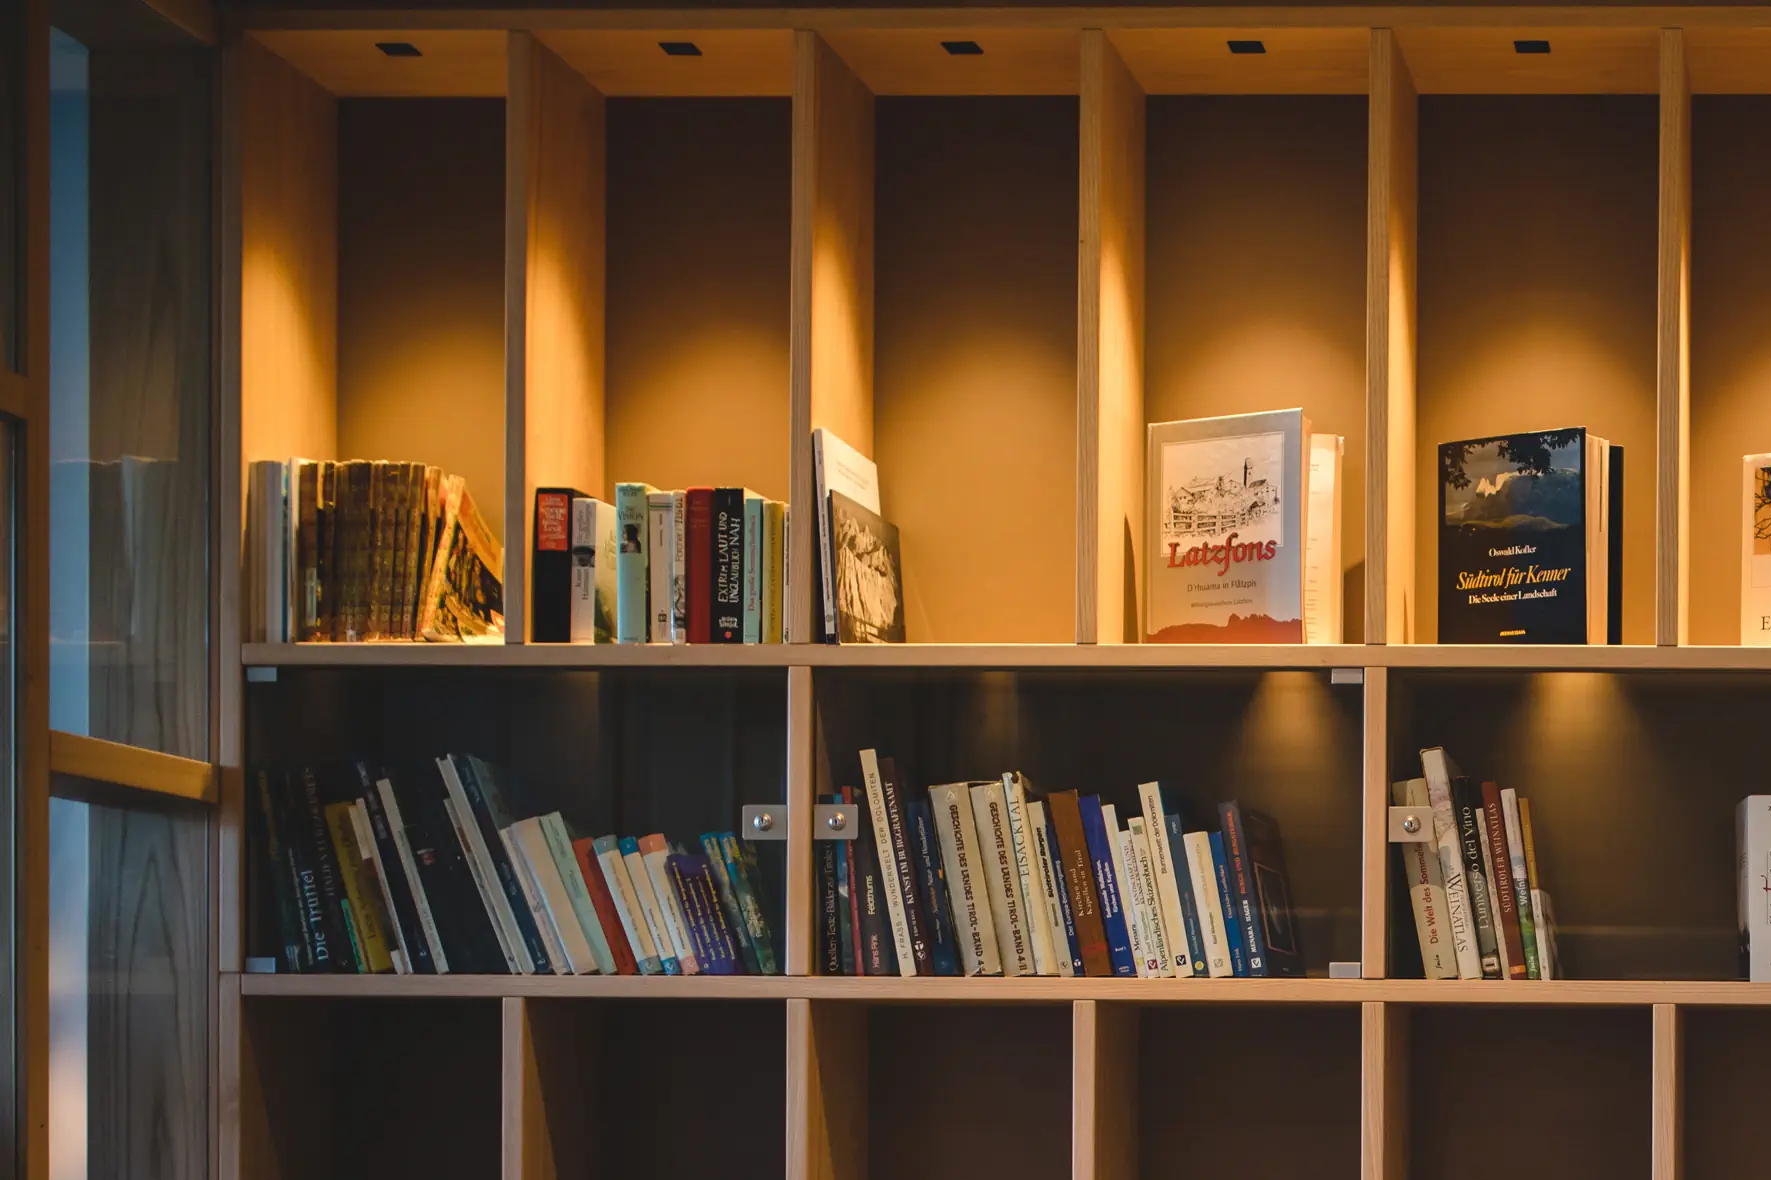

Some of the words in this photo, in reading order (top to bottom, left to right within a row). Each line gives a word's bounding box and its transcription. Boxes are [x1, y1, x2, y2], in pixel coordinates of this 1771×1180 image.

[718, 511, 728, 531] UND
[729, 516, 741, 546] NAH
[718, 533, 729, 562] LAUT
[1167, 532, 1277, 576] Latzfons
[1488, 545, 1514, 557] Oswald
[1514, 544, 1537, 556] Kofler
[1456, 567, 1505, 591] Südtirol
[1504, 566, 1527, 589] für
[1525, 565, 1572, 583] Kenner
[1469, 594, 1482, 604] Die
[1481, 593, 1500, 603] Seele
[1499, 591, 1518, 601] einer
[1518, 588, 1557, 600] Landschaft
[868, 773, 883, 822] DOLOMITEN
[879, 827, 887, 844] DER
[950, 805, 964, 851] GESCHICHTE
[989, 802, 1004, 849] GESCHICHTE
[1462, 807, 1472, 836] Vino
[1489, 802, 1503, 855] WEINATLAS
[1009, 796, 1030, 877] EISACKTAL
[1035, 827, 1046, 856] Burgen
[1466, 839, 1477, 860] del
[958, 852, 967, 868] DES
[998, 850, 1007, 865] DES
[1075, 850, 1084, 867] Tirol
[883, 849, 899, 908] WUNDERWELT
[960, 868, 973, 900] LANDES
[1001, 866, 1013, 898] LANDES
[1042, 858, 1054, 898] Südtiroler
[1080, 870, 1086, 879] in
[1107, 883, 1115, 894] und
[1140, 856, 1156, 906] Skizzenbuch
[1498, 857, 1511, 913] SÜDTIROLER
[901, 874, 914, 905] KUNST
[1072, 885, 1084, 916] Kirchen
[1081, 881, 1093, 915] Kapellen
[1423, 887, 1432, 903] des
[1471, 863, 1489, 929] L'universo
[1243, 899, 1252, 922] HAGER
[1425, 905, 1435, 927] Welt
[1447, 873, 1468, 952] WEINATLAS
[1131, 923, 1140, 951] Menara
[1150, 907, 1169, 972] Alpenländisches
[1247, 926, 1257, 953] MENARA
[1430, 928, 1439, 944] Die
